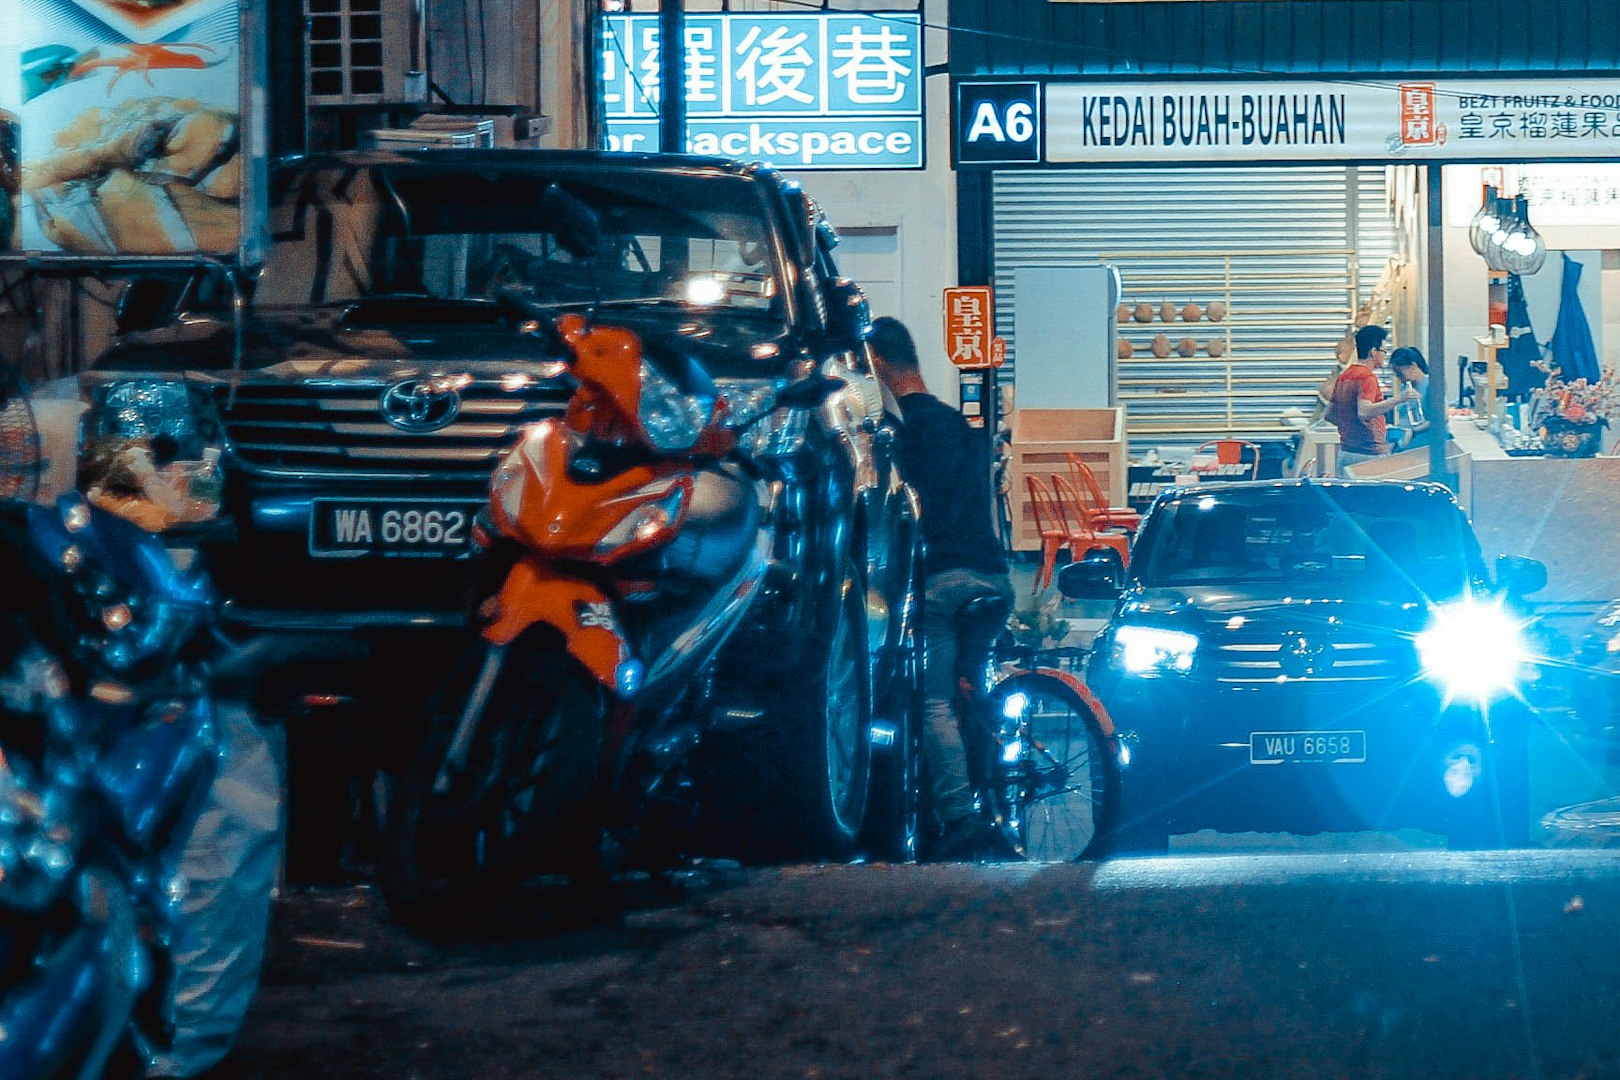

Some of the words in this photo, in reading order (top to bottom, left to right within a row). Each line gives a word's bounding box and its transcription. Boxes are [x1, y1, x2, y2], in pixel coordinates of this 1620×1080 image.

[968, 102, 1034, 142] A6
[1082, 95, 1154, 146] KEDAI
[1162, 94, 1345, 146] BUAH-BUAHAN
[1459, 95, 1498, 109] BEZT
[1503, 95, 1560, 109] FRUITZ
[1564, 95, 1577, 108] &
[686, 124, 912, 164] ackspace
[952, 295, 984, 361] 皇京
[335, 510, 372, 544] WA
[381, 510, 465, 544] 6862
[1265, 737, 1295, 756] VAU
[1304, 736, 1350, 755] 6658
